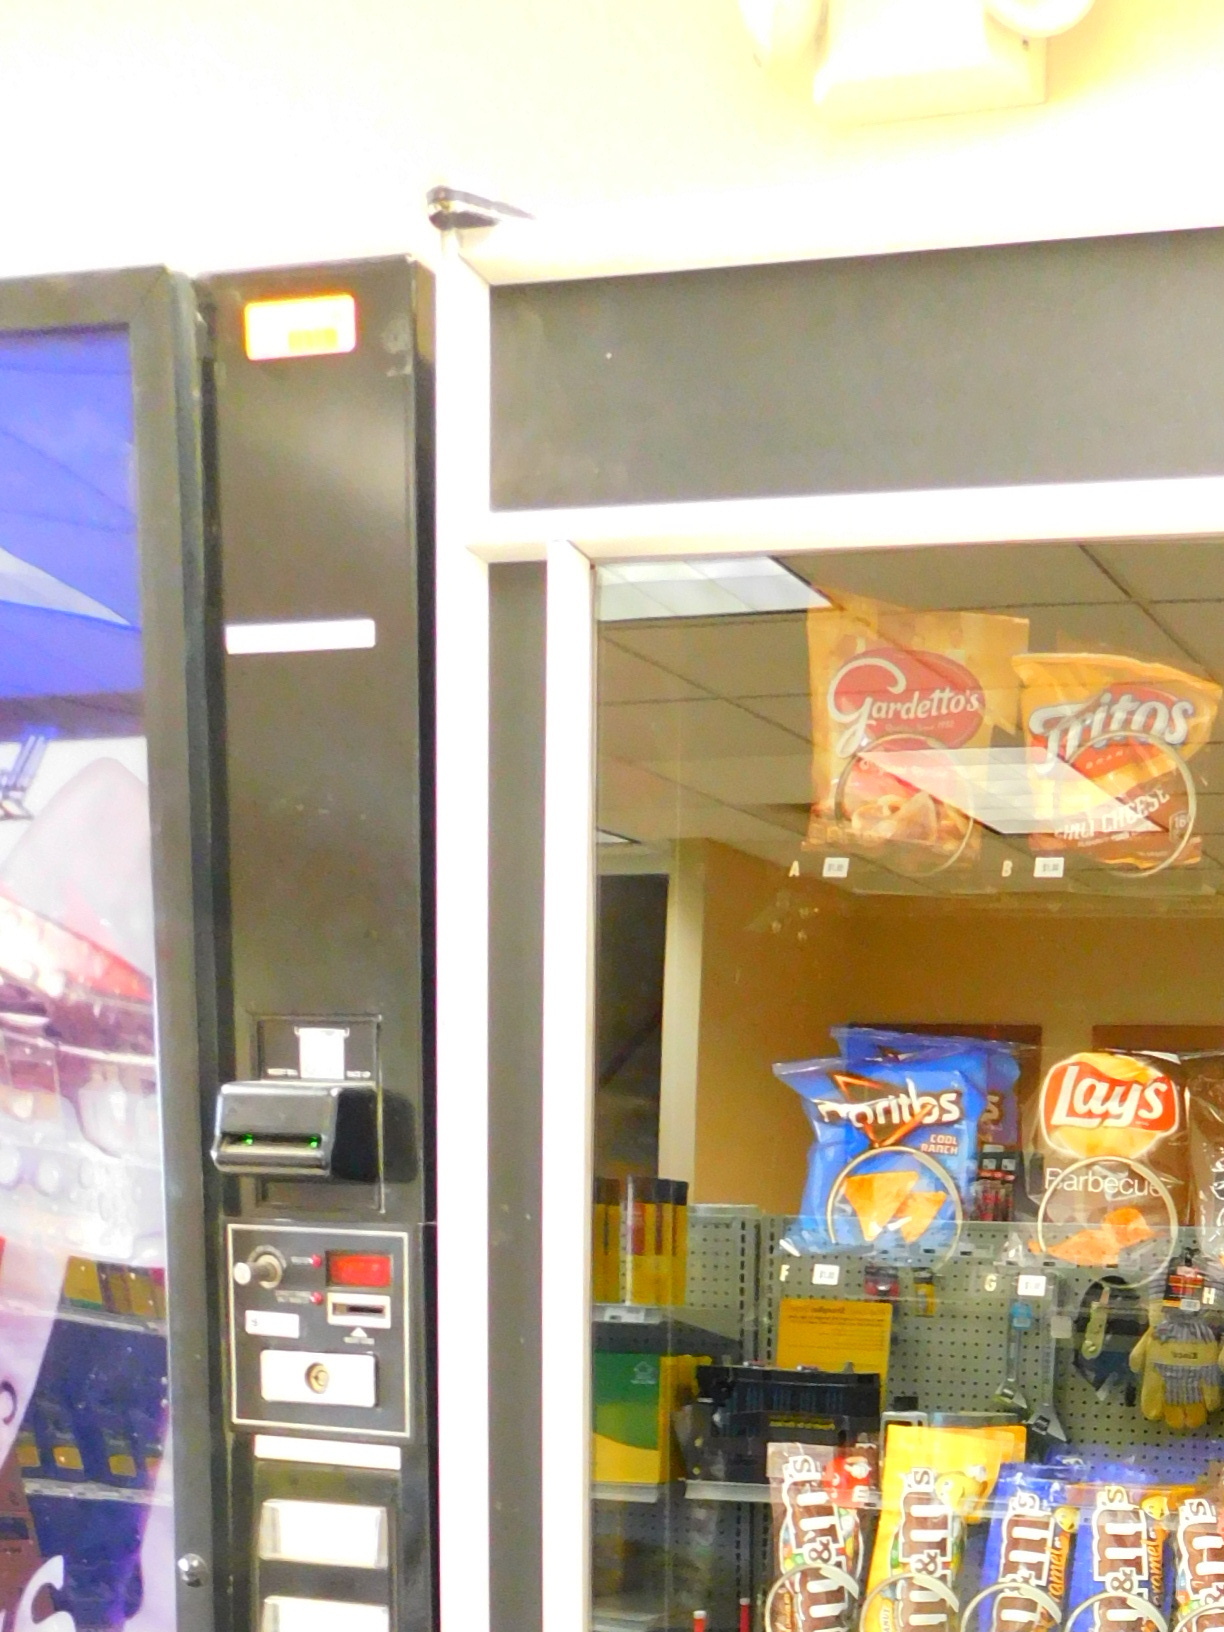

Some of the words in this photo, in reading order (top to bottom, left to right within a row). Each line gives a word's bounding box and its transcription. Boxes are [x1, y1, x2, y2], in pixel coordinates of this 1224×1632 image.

[827, 657, 979, 758] Gardetto's
[788, 860, 800, 877] A
[1002, 860, 1013, 877] B
[1051, 1065, 1168, 1128] Lay's
[930, 1133, 958, 1145] COOL
[921, 1143, 959, 1155] RANCH
[1045, 1165, 1166, 1197] Barbecue
[780, 1264, 790, 1282] F
[984, 1274, 997, 1292] G
[1202, 1287, 1215, 1305] H
